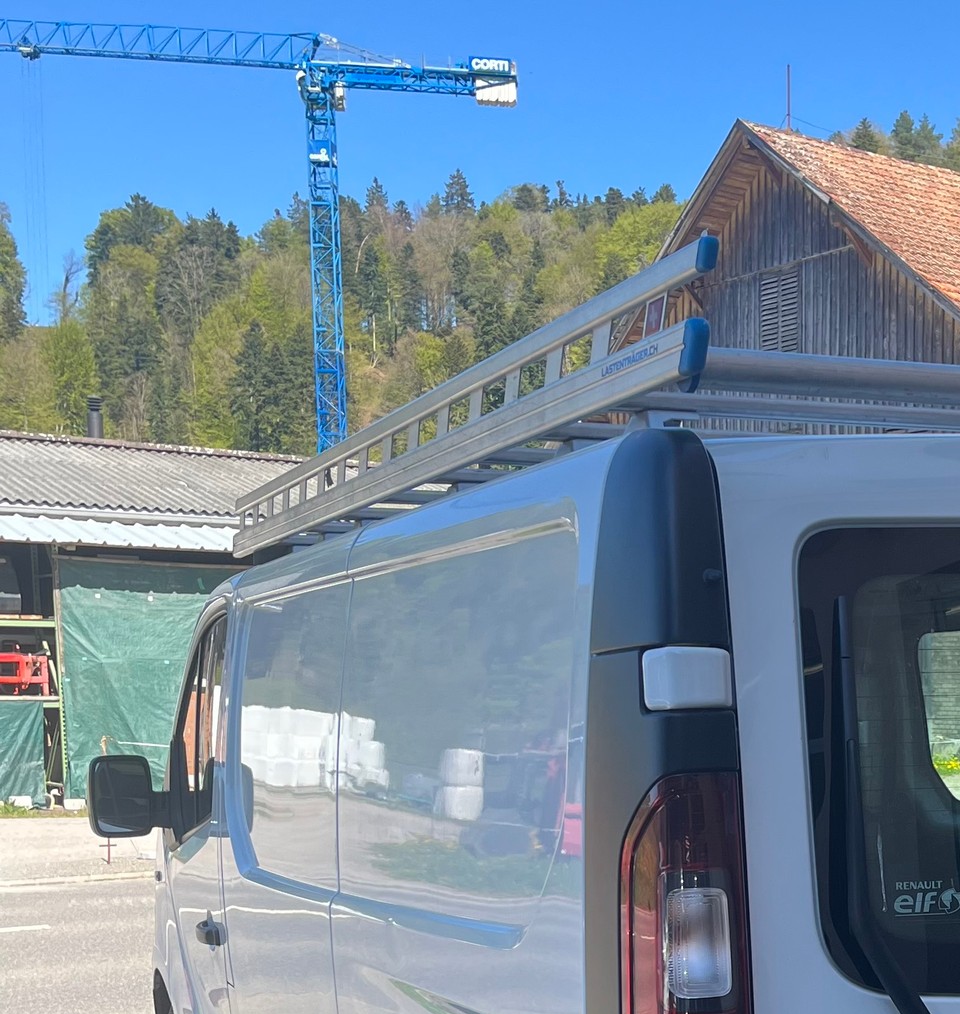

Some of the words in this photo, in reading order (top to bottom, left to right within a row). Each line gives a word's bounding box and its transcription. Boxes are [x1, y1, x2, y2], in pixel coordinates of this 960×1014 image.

[471, 58, 509, 71] CORTI
[895, 880, 943, 890] RENAULT
[894, 892, 937, 913] elf
